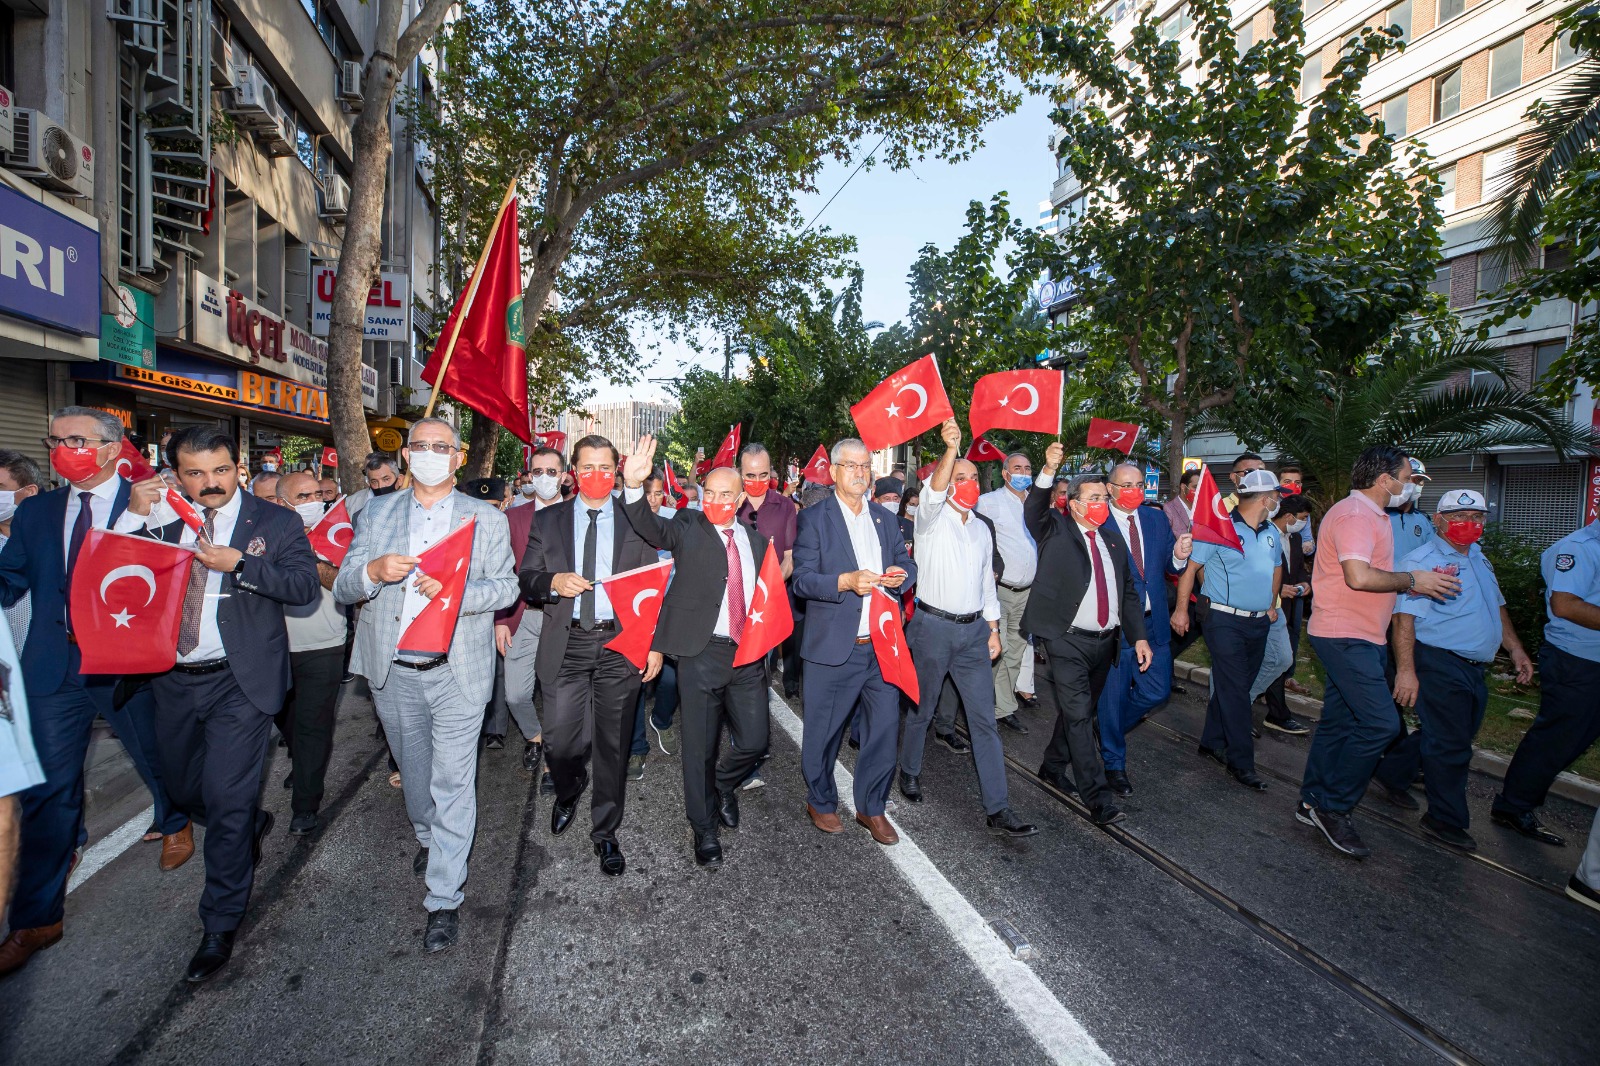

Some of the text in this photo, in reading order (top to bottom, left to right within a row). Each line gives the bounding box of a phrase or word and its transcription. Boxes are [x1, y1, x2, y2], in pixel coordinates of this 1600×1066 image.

[82, 160, 91, 171] LG
[318, 270, 401, 307] ÜEL
[225, 289, 288, 364] ÜÇEL
[368, 316, 403, 326] SANAT
[290, 327, 318, 359] MODA
